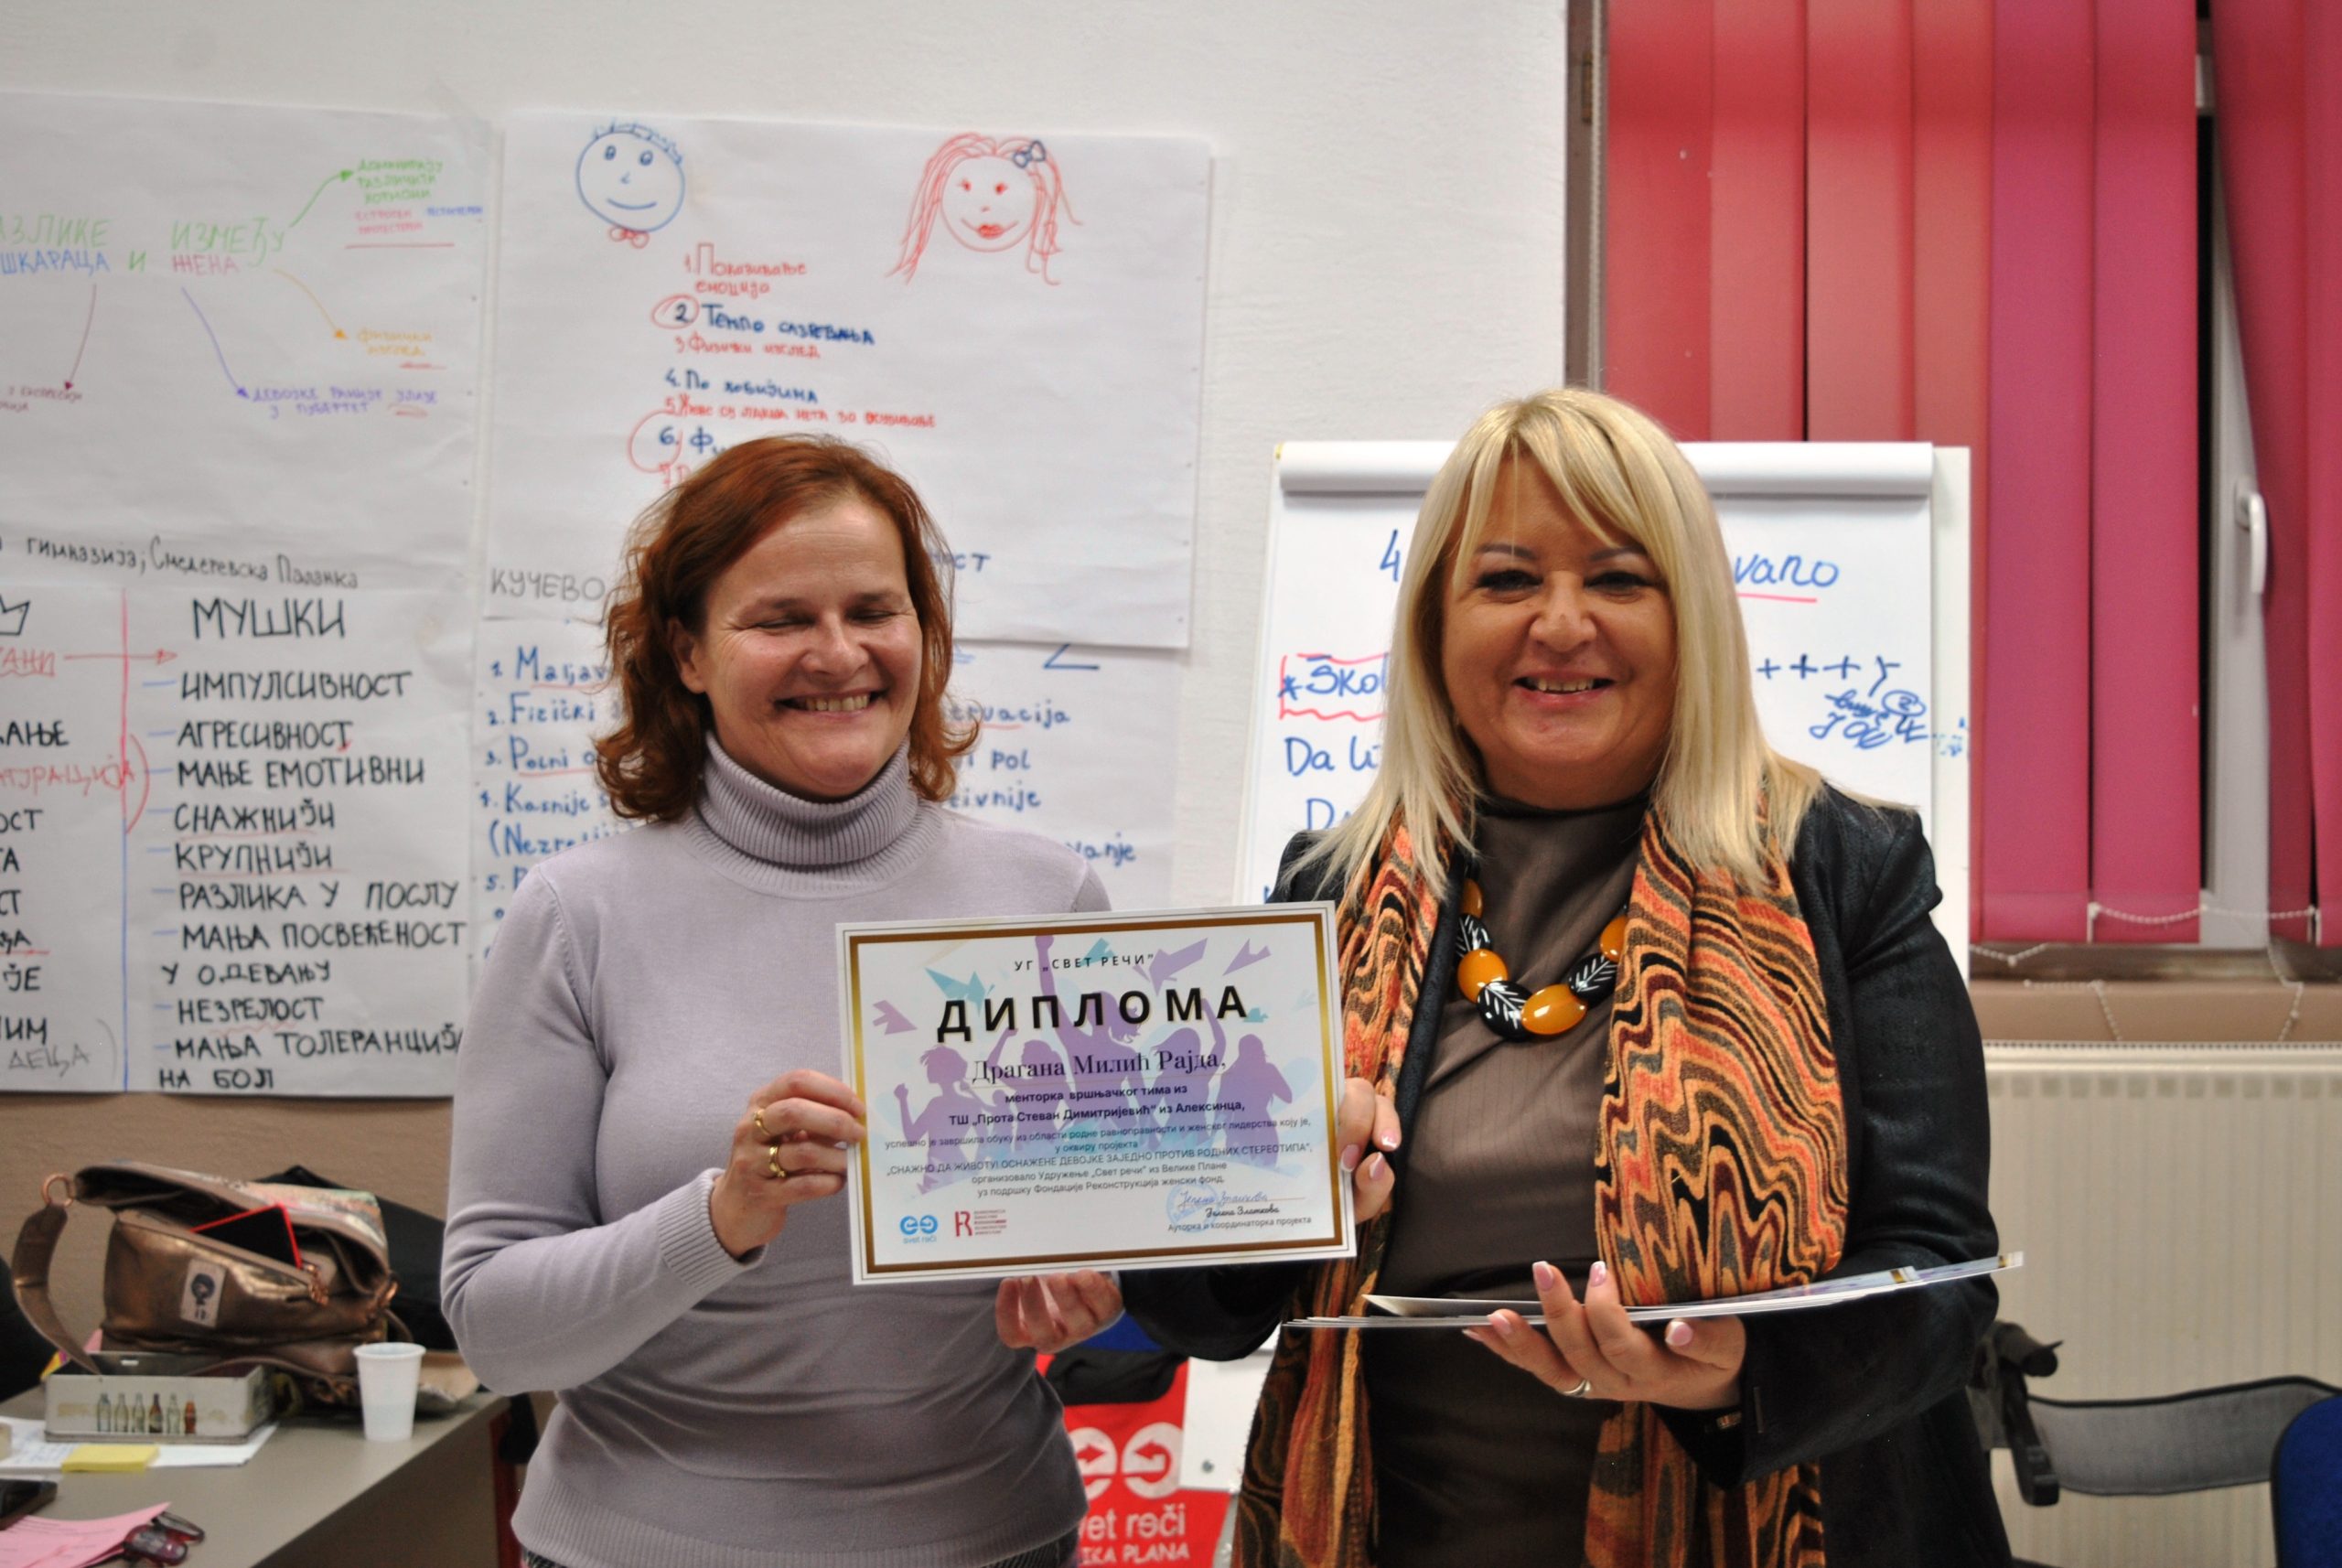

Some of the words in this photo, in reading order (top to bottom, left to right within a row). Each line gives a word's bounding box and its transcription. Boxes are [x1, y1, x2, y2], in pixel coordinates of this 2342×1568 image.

[128, 250, 146, 273] И
[171, 253, 241, 276] ЖЕНА
[490, 567, 607, 603] КУЧЕВО
[192, 597, 346, 639] МУШКИ
[181, 670, 413, 702] ИМПУЛСИВНОСТ
[177, 720, 354, 751] АГРЕСИВНОСТ
[1283, 736, 1336, 777] Da
[177, 759, 253, 789] МАЊЕ
[265, 756, 425, 789] ЕМОТИВНИ
[179, 881, 306, 911] РАЗЛИКА
[319, 880, 340, 908] У
[364, 880, 460, 911] ПОСЛУ
[181, 922, 270, 952] МАЊА
[282, 919, 468, 950] ПОСВЕЋЕНОСТ
[161, 961, 179, 985] У
[1014, 960, 1034, 972] УГ
[177, 995, 326, 1025] НЕЗРЕЛОСТ
[936, 984, 1249, 1044] ДИПЛОМА
[175, 1034, 263, 1062] МАЊА
[274, 1022, 464, 1058] ТОЛЕРАНЦИЈ
[159, 1067, 191, 1090] НА
[213, 1068, 274, 1090] БОЛ
[972, 1058, 1067, 1085] Драгана
[1073, 1051, 1151, 1076] Милић
[1155, 1048, 1227, 1075] Рајда,
[1004, 1090, 1065, 1103] менторка
[1069, 1087, 1139, 1101] вршњачког
[1142, 1085, 1172, 1096] тима
[1174, 1085, 1188, 1095] из
[949, 1114, 970, 1126] ТШ
[1016, 1110, 1060, 1122] Стеван
[1158, 1105, 1173, 1115] из
[986, 1133, 1014, 1146] обуку
[1028, 1130, 1068, 1142] области
[1054, 1144, 1061, 1155] у
[1062, 1141, 1096, 1154] оквиру
[1197, 1161, 1228, 1172] Плане
[1122, 1541, 1191, 1565] PLANA
